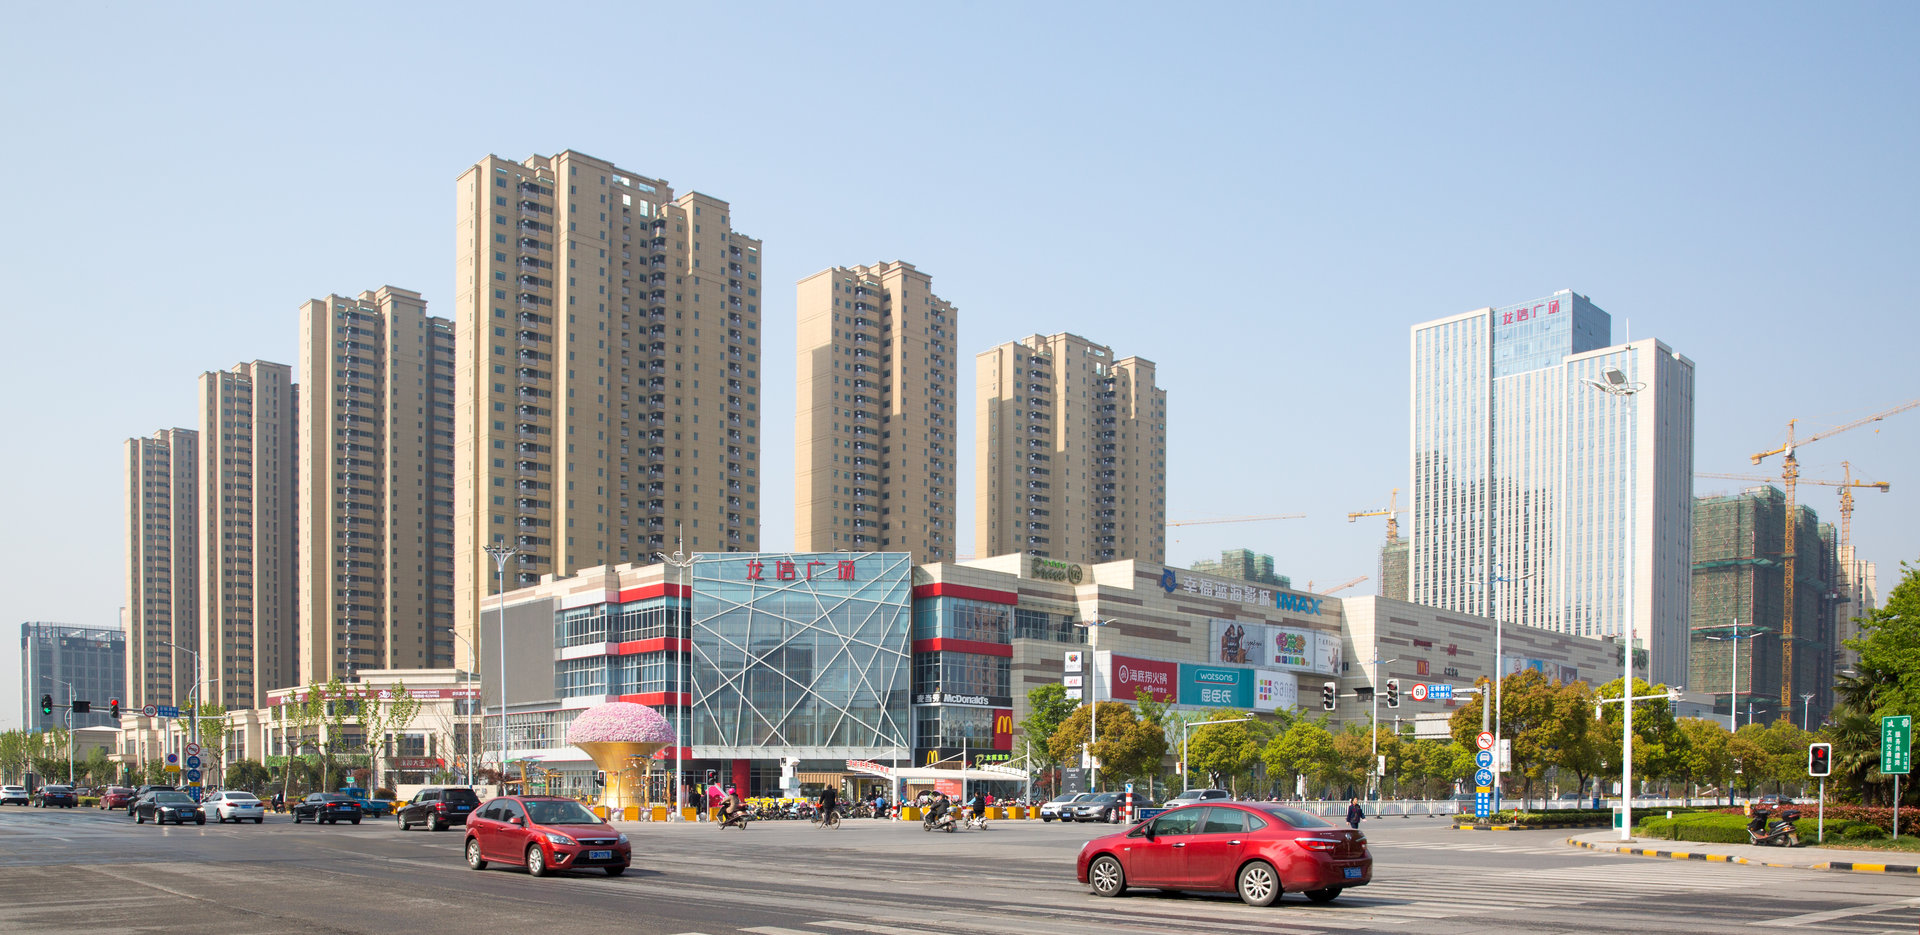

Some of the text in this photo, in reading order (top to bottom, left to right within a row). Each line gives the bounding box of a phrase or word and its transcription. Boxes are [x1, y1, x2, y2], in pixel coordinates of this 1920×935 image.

[1503, 300, 1560, 325] 龙信广场
[746, 560, 856, 580] 龙信广场
[1183, 575, 1323, 616] 幸福蓝海影城 IMAX
[1129, 669, 1168, 685] 海底捞火锅
[917, 694, 989, 705] 麦当劳 McDonald's
[1201, 688, 1232, 703] 屈臣氏
[1415, 689, 1424, 697] 60
